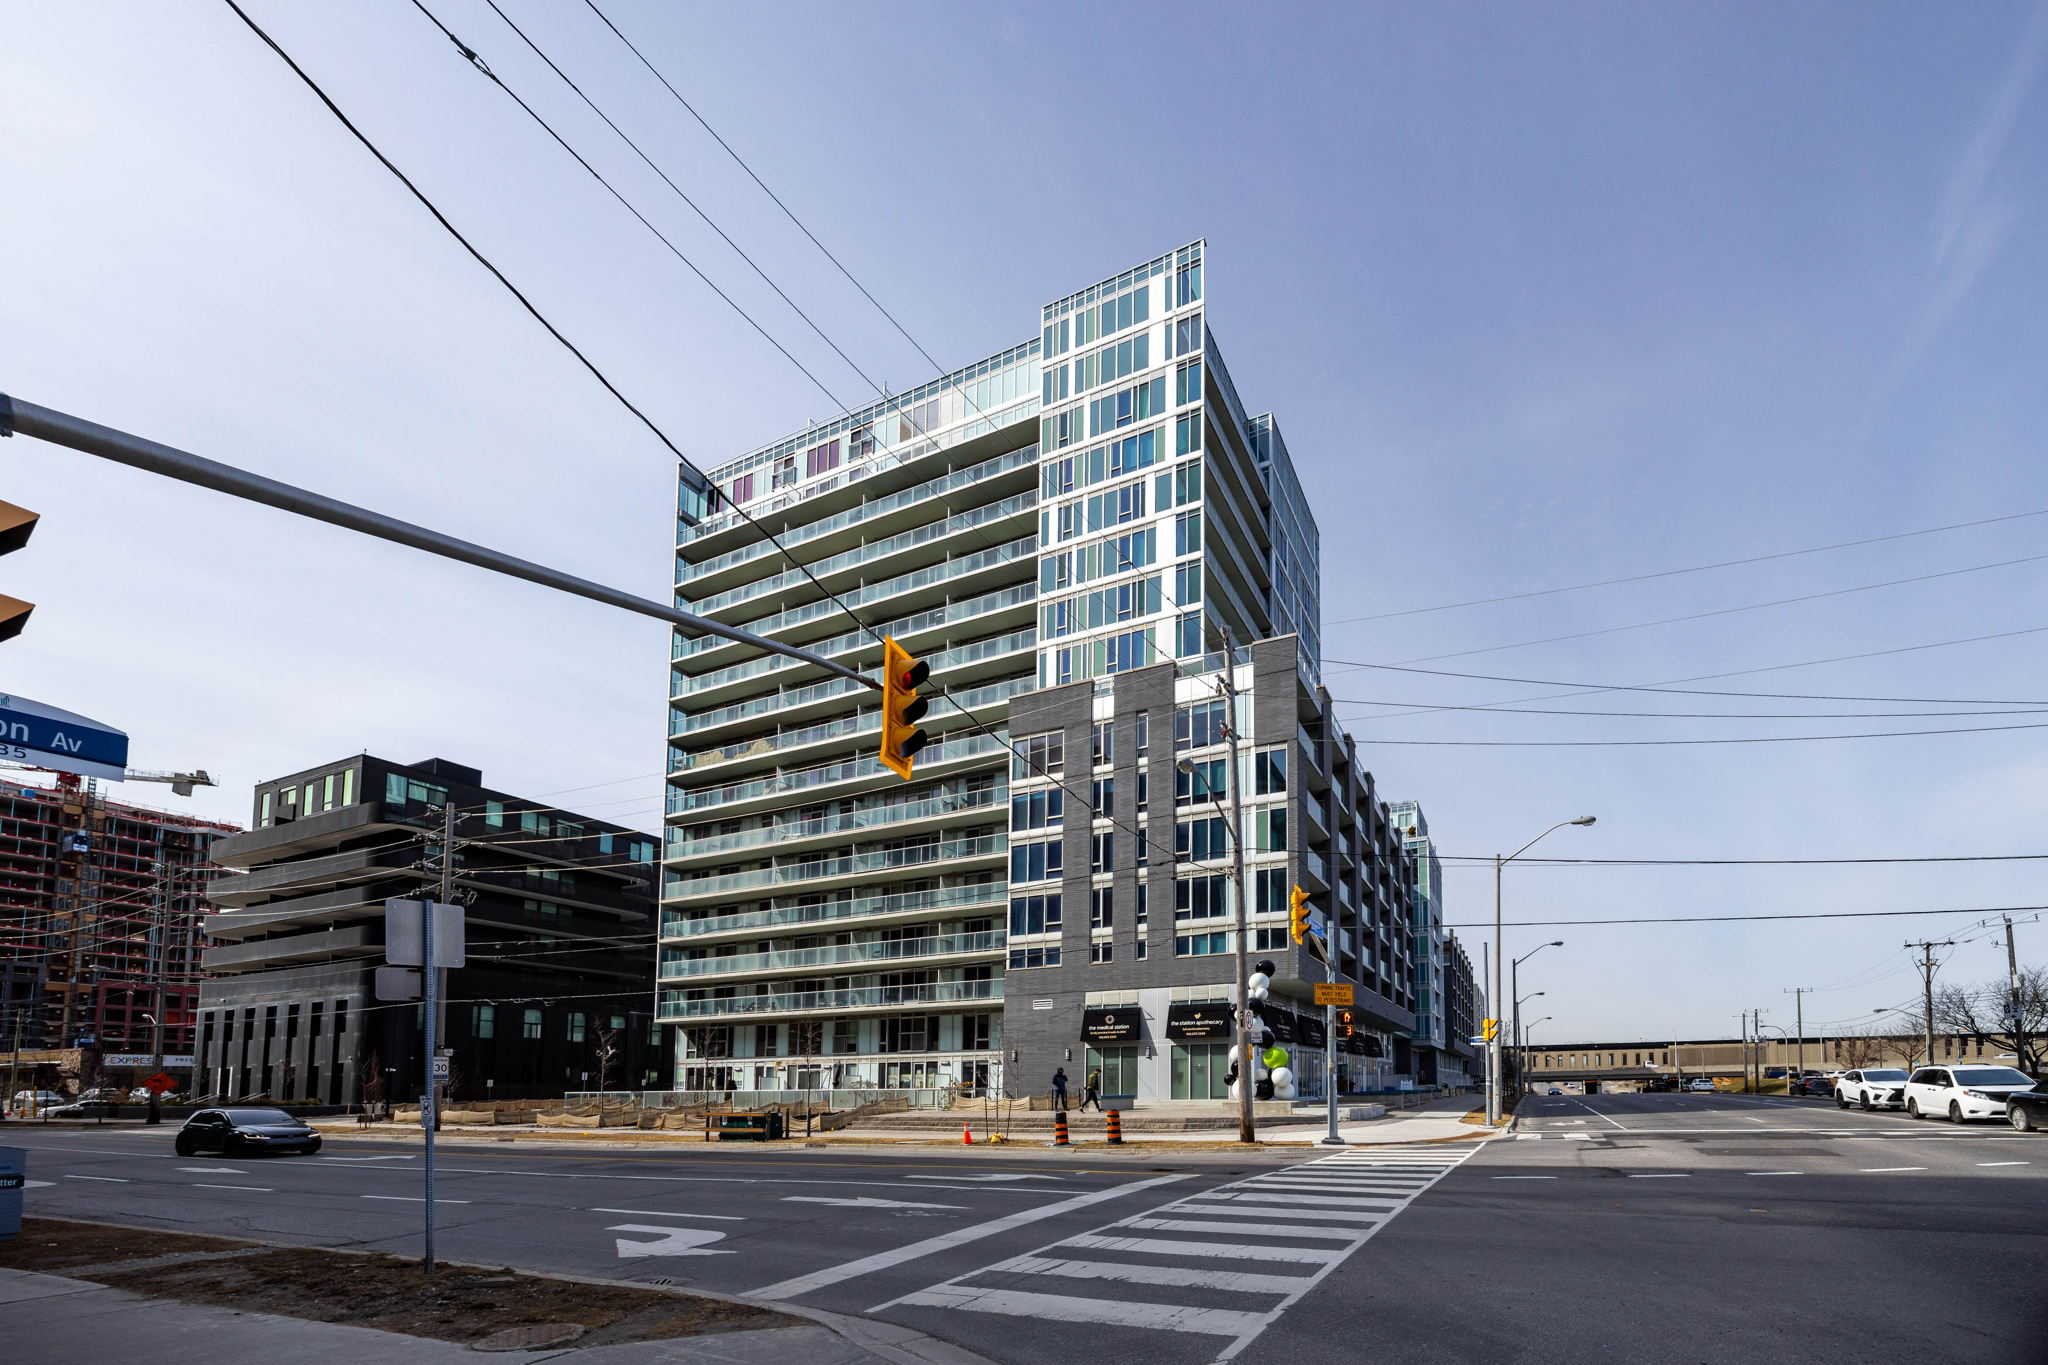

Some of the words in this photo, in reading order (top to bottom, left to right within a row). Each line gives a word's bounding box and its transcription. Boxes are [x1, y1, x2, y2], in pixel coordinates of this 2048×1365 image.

[51, 732, 82, 752] Av
[1347, 1026, 1352, 1035] 3
[109, 1056, 153, 1065] EXPRES
[434, 1064, 447, 1072] 30
